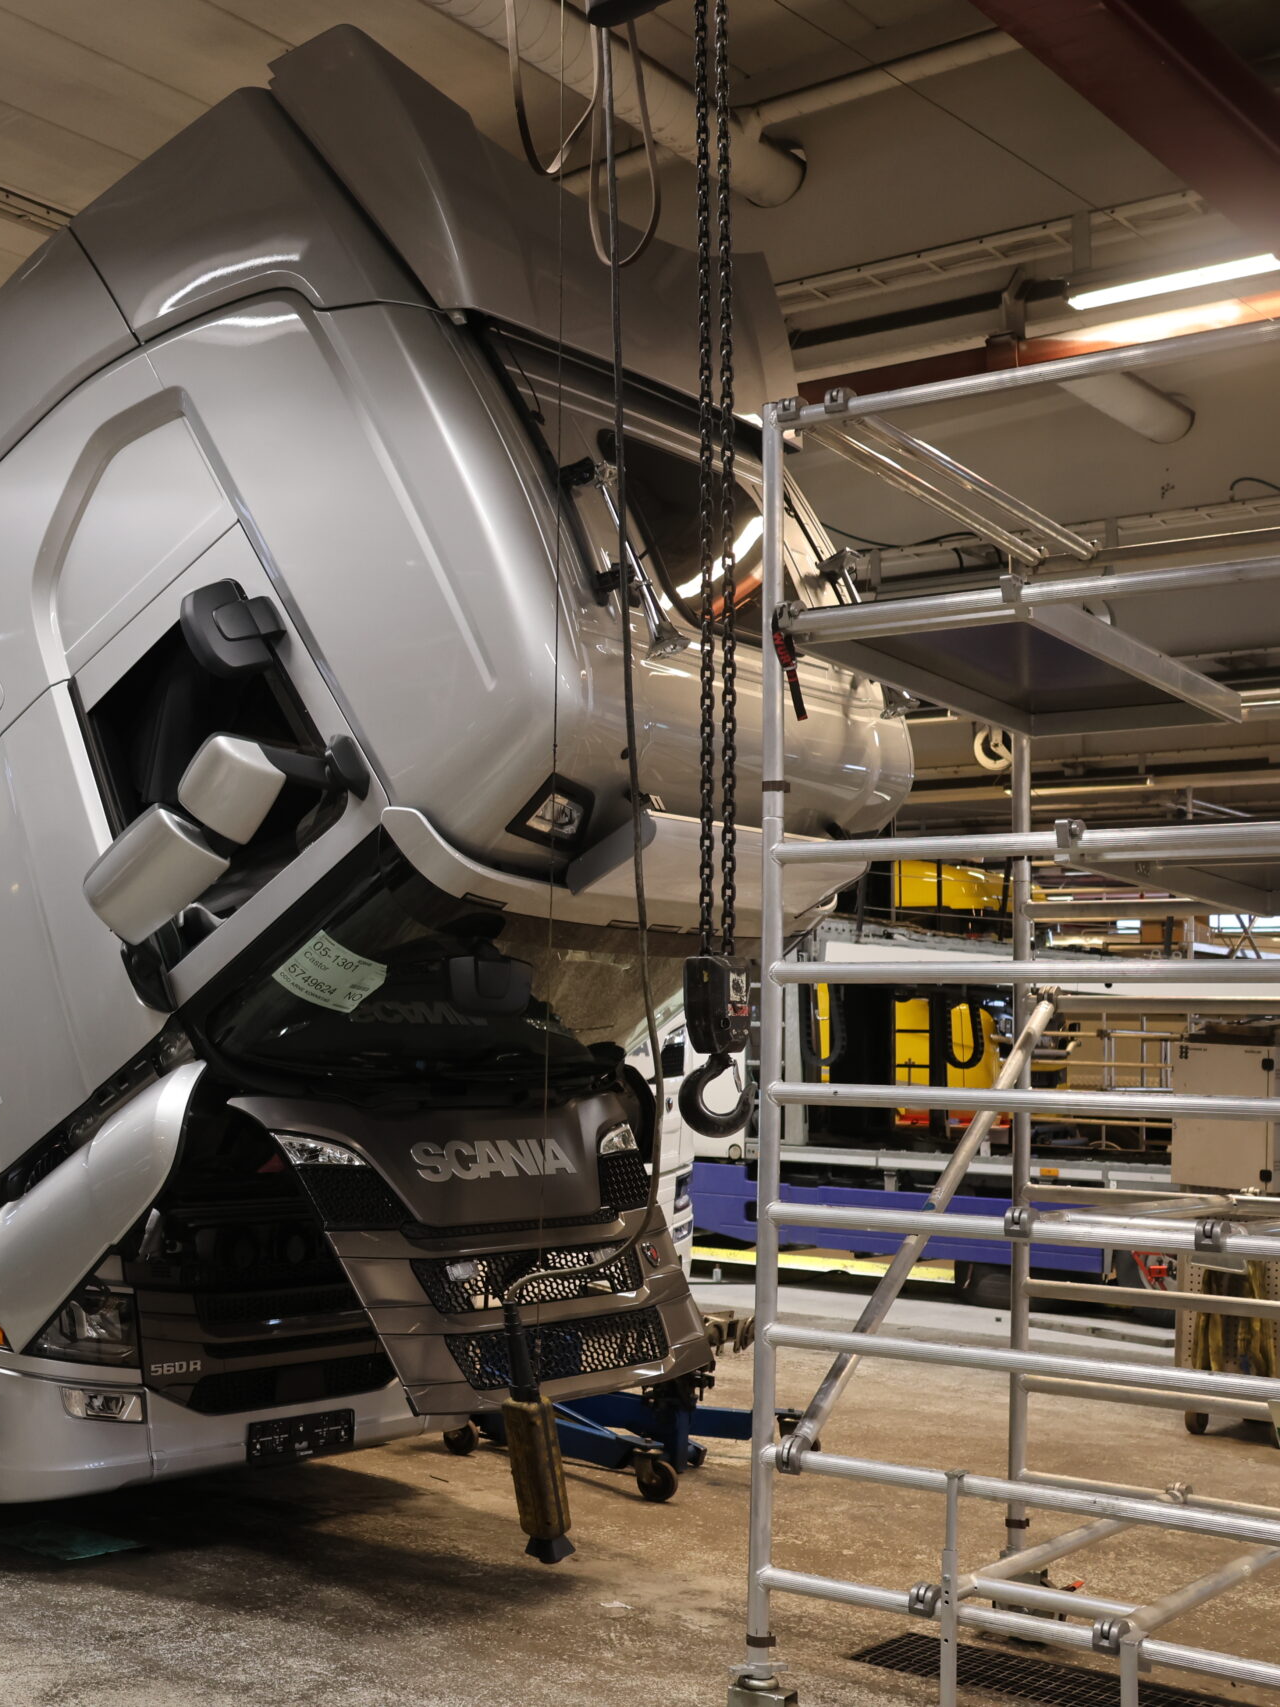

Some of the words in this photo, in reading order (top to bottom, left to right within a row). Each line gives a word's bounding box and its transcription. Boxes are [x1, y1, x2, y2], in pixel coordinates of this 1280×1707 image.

[304, 951, 329, 971] Castor
[312, 941, 360, 973] 05-1301
[288, 963, 337, 996] 5749624
[344, 991, 363, 1002] NO
[410, 1138, 577, 1182] SCANIA
[150, 1361, 187, 1376] 560
[189, 1360, 202, 1373] R
